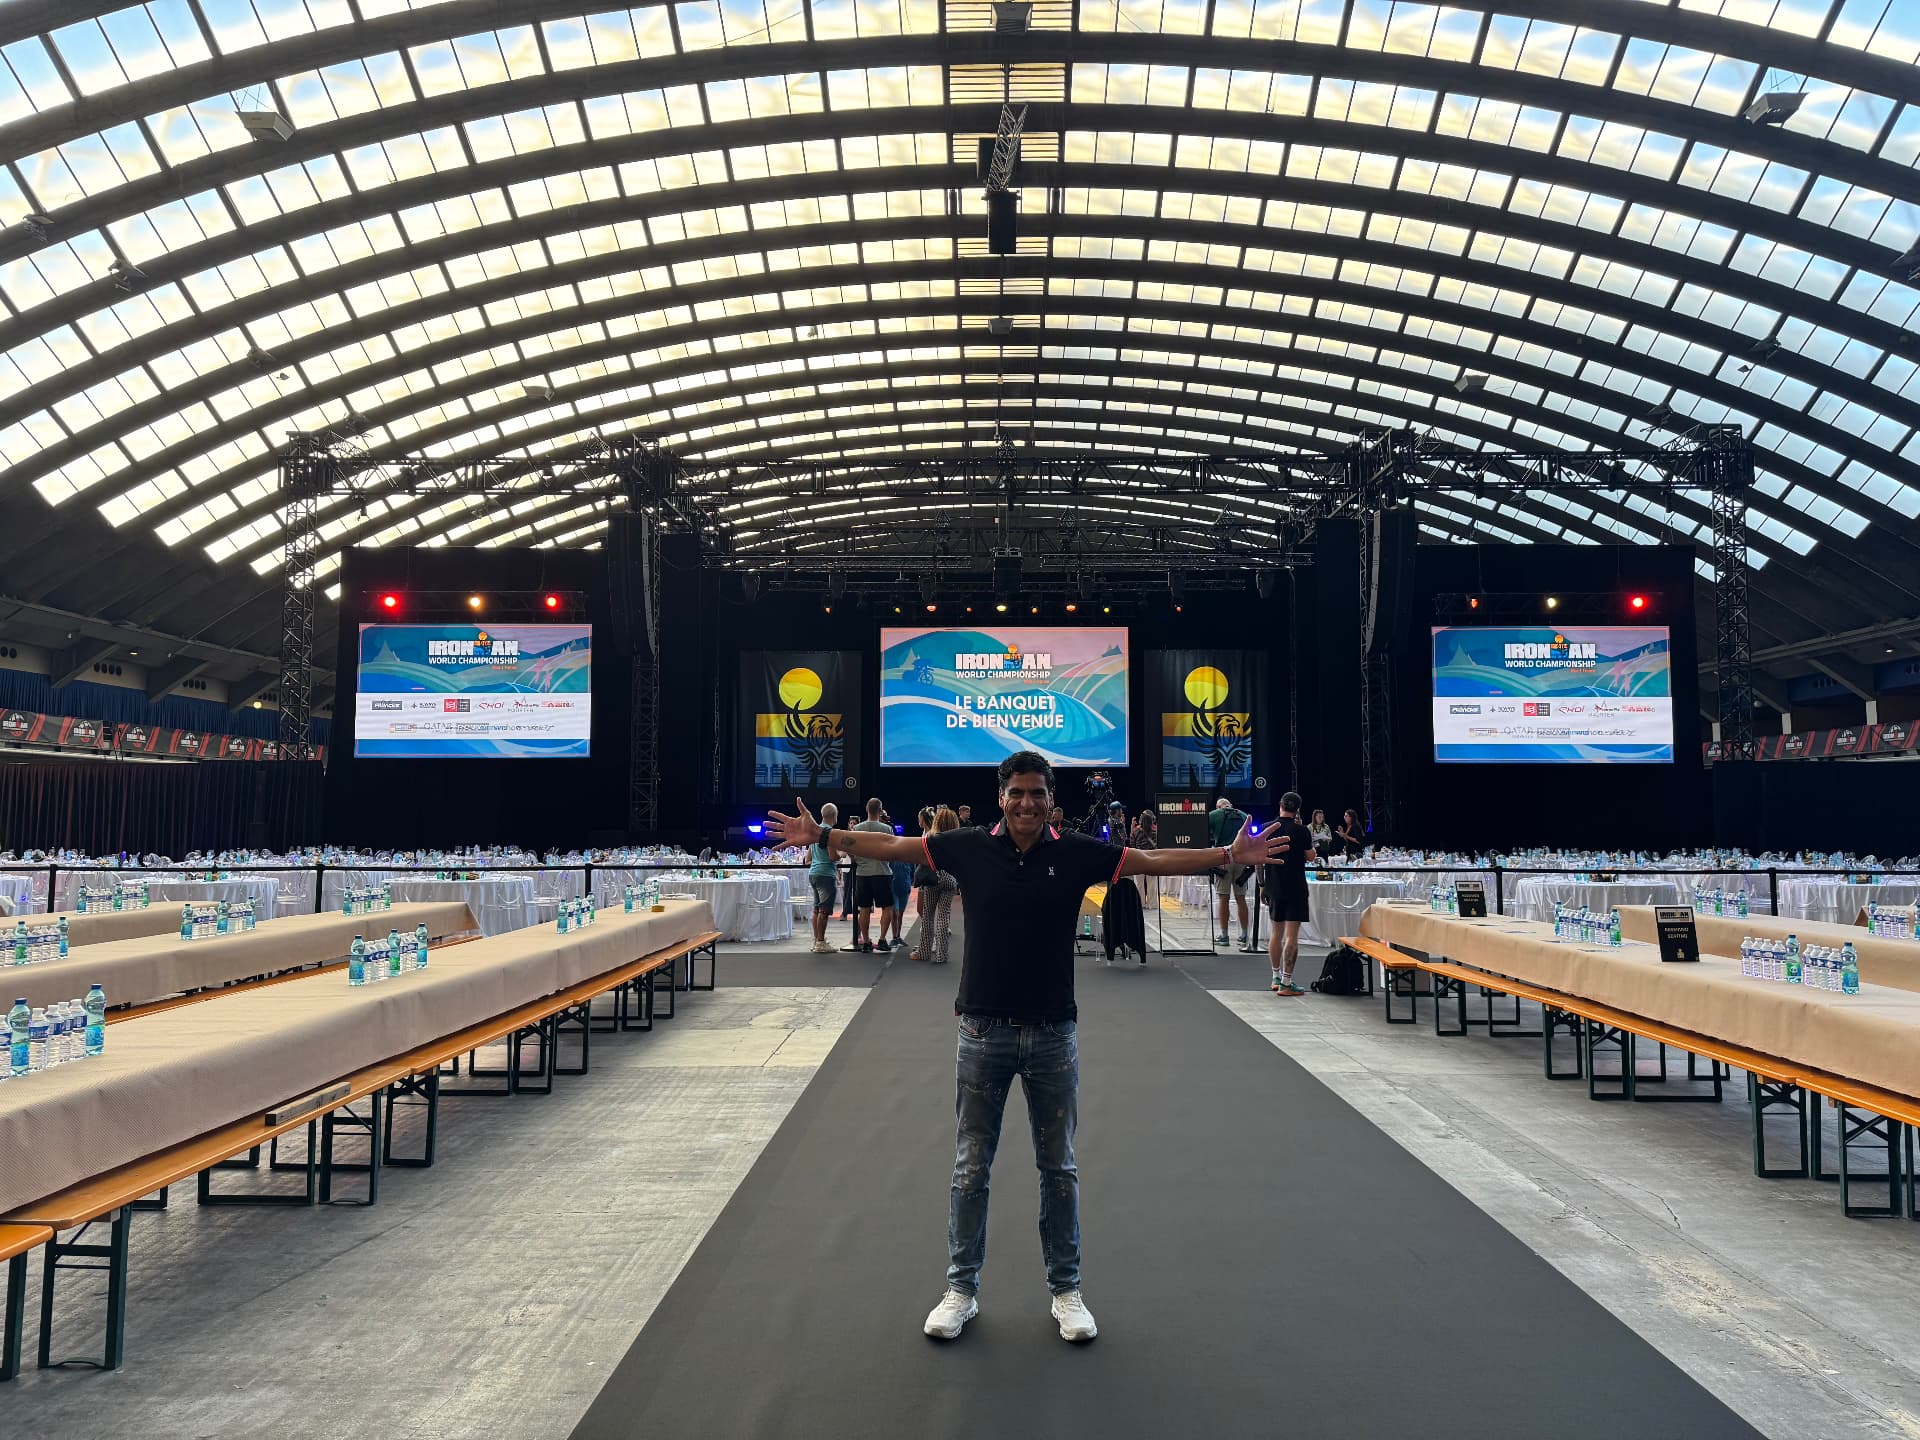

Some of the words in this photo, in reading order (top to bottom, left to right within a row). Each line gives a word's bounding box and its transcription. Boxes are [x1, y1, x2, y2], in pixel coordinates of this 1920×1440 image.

[428, 657, 457, 665] WORLD
[458, 656, 518, 665] CHAMPIONSHIP
[1504, 660, 1534, 668] WORLD
[1535, 660, 1596, 668] CHAMPIONSHIP
[955, 670, 986, 679] WORLD
[987, 670, 1051, 679] CHAMPIONSHIP
[955, 695, 972, 710] LE
[977, 695, 1055, 710] BANQUET
[946, 714, 967, 729] DE
[972, 714, 1064, 729] BIENVENUE
[1159, 799, 1206, 812] IRONMAN
[1175, 835, 1191, 844] VIP
